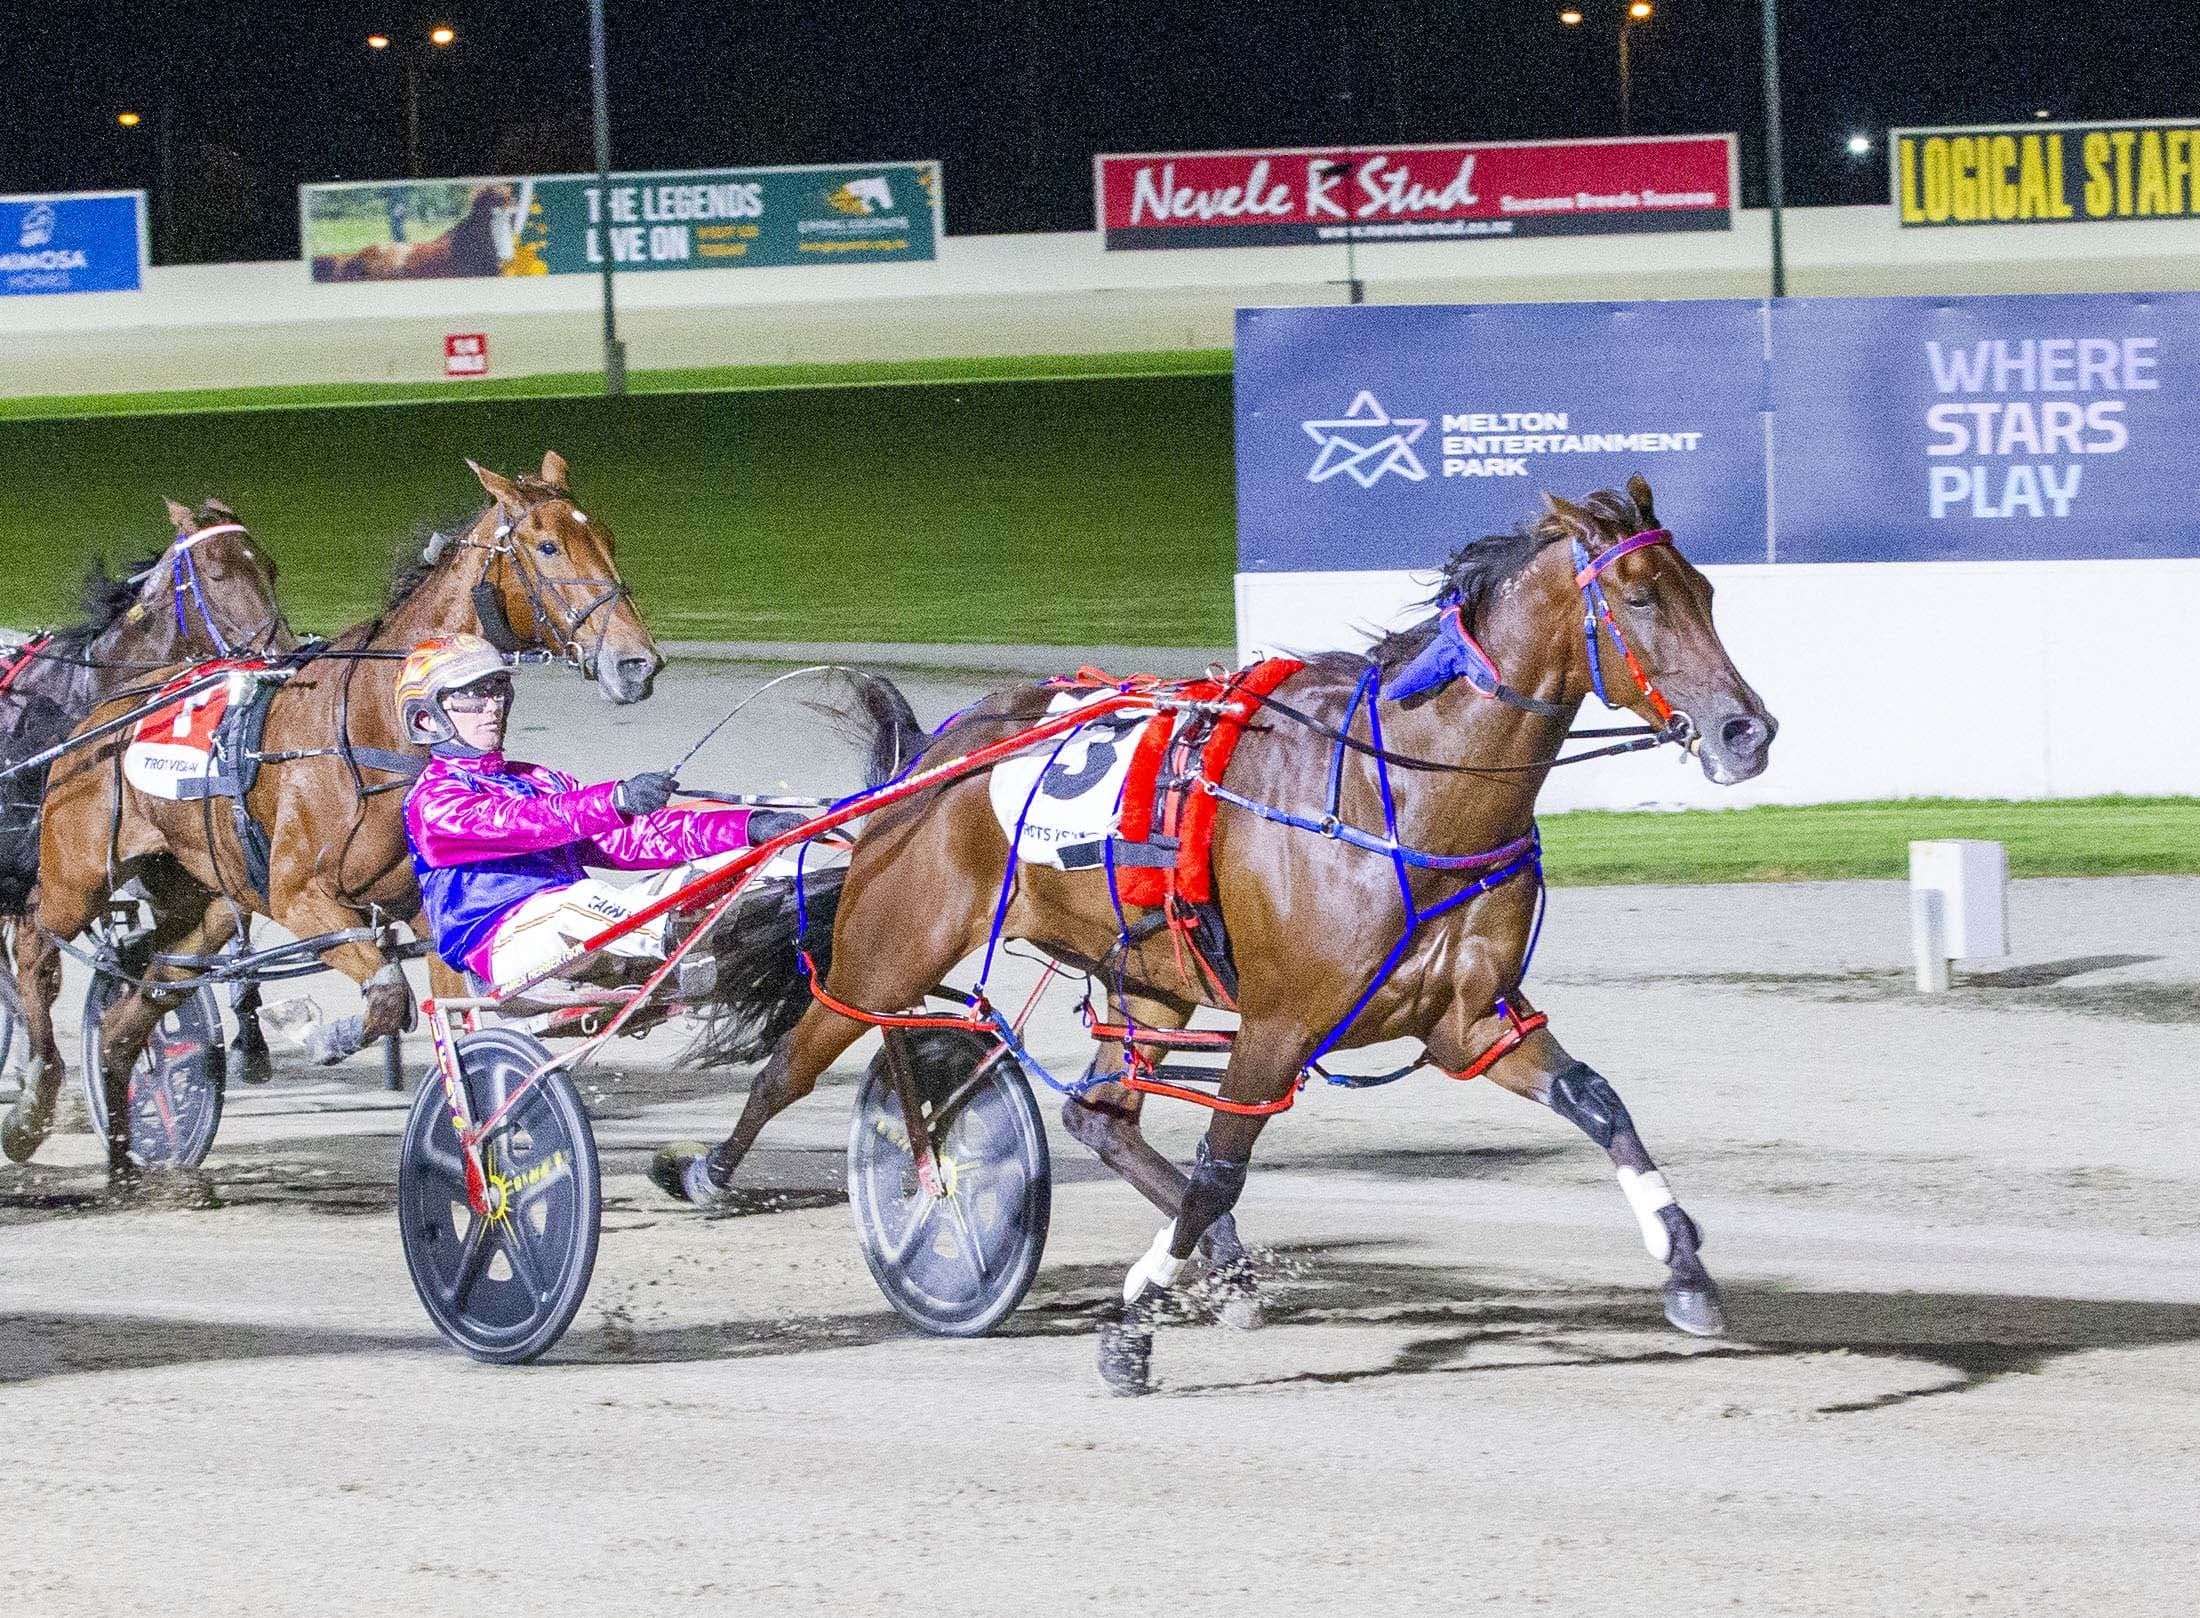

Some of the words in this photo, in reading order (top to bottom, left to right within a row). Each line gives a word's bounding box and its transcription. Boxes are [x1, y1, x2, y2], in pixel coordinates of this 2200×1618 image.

[1131, 160, 1294, 226] Nevele
[1358, 154, 1479, 218] Stud
[1902, 133, 2073, 222] LOGICAL
[585, 187, 639, 223] THE
[643, 183, 764, 221] LEGENDS
[586, 226, 647, 263] LVE
[650, 226, 689, 261] ON
[1925, 337, 2160, 392] WHERE
[1442, 413, 1568, 432] MELTON
[1443, 432, 1702, 455] ENTERTAINMENT
[1926, 400, 2129, 456] STARS
[1443, 458, 1528, 477] PARK
[1928, 464, 2082, 519] PLAY
